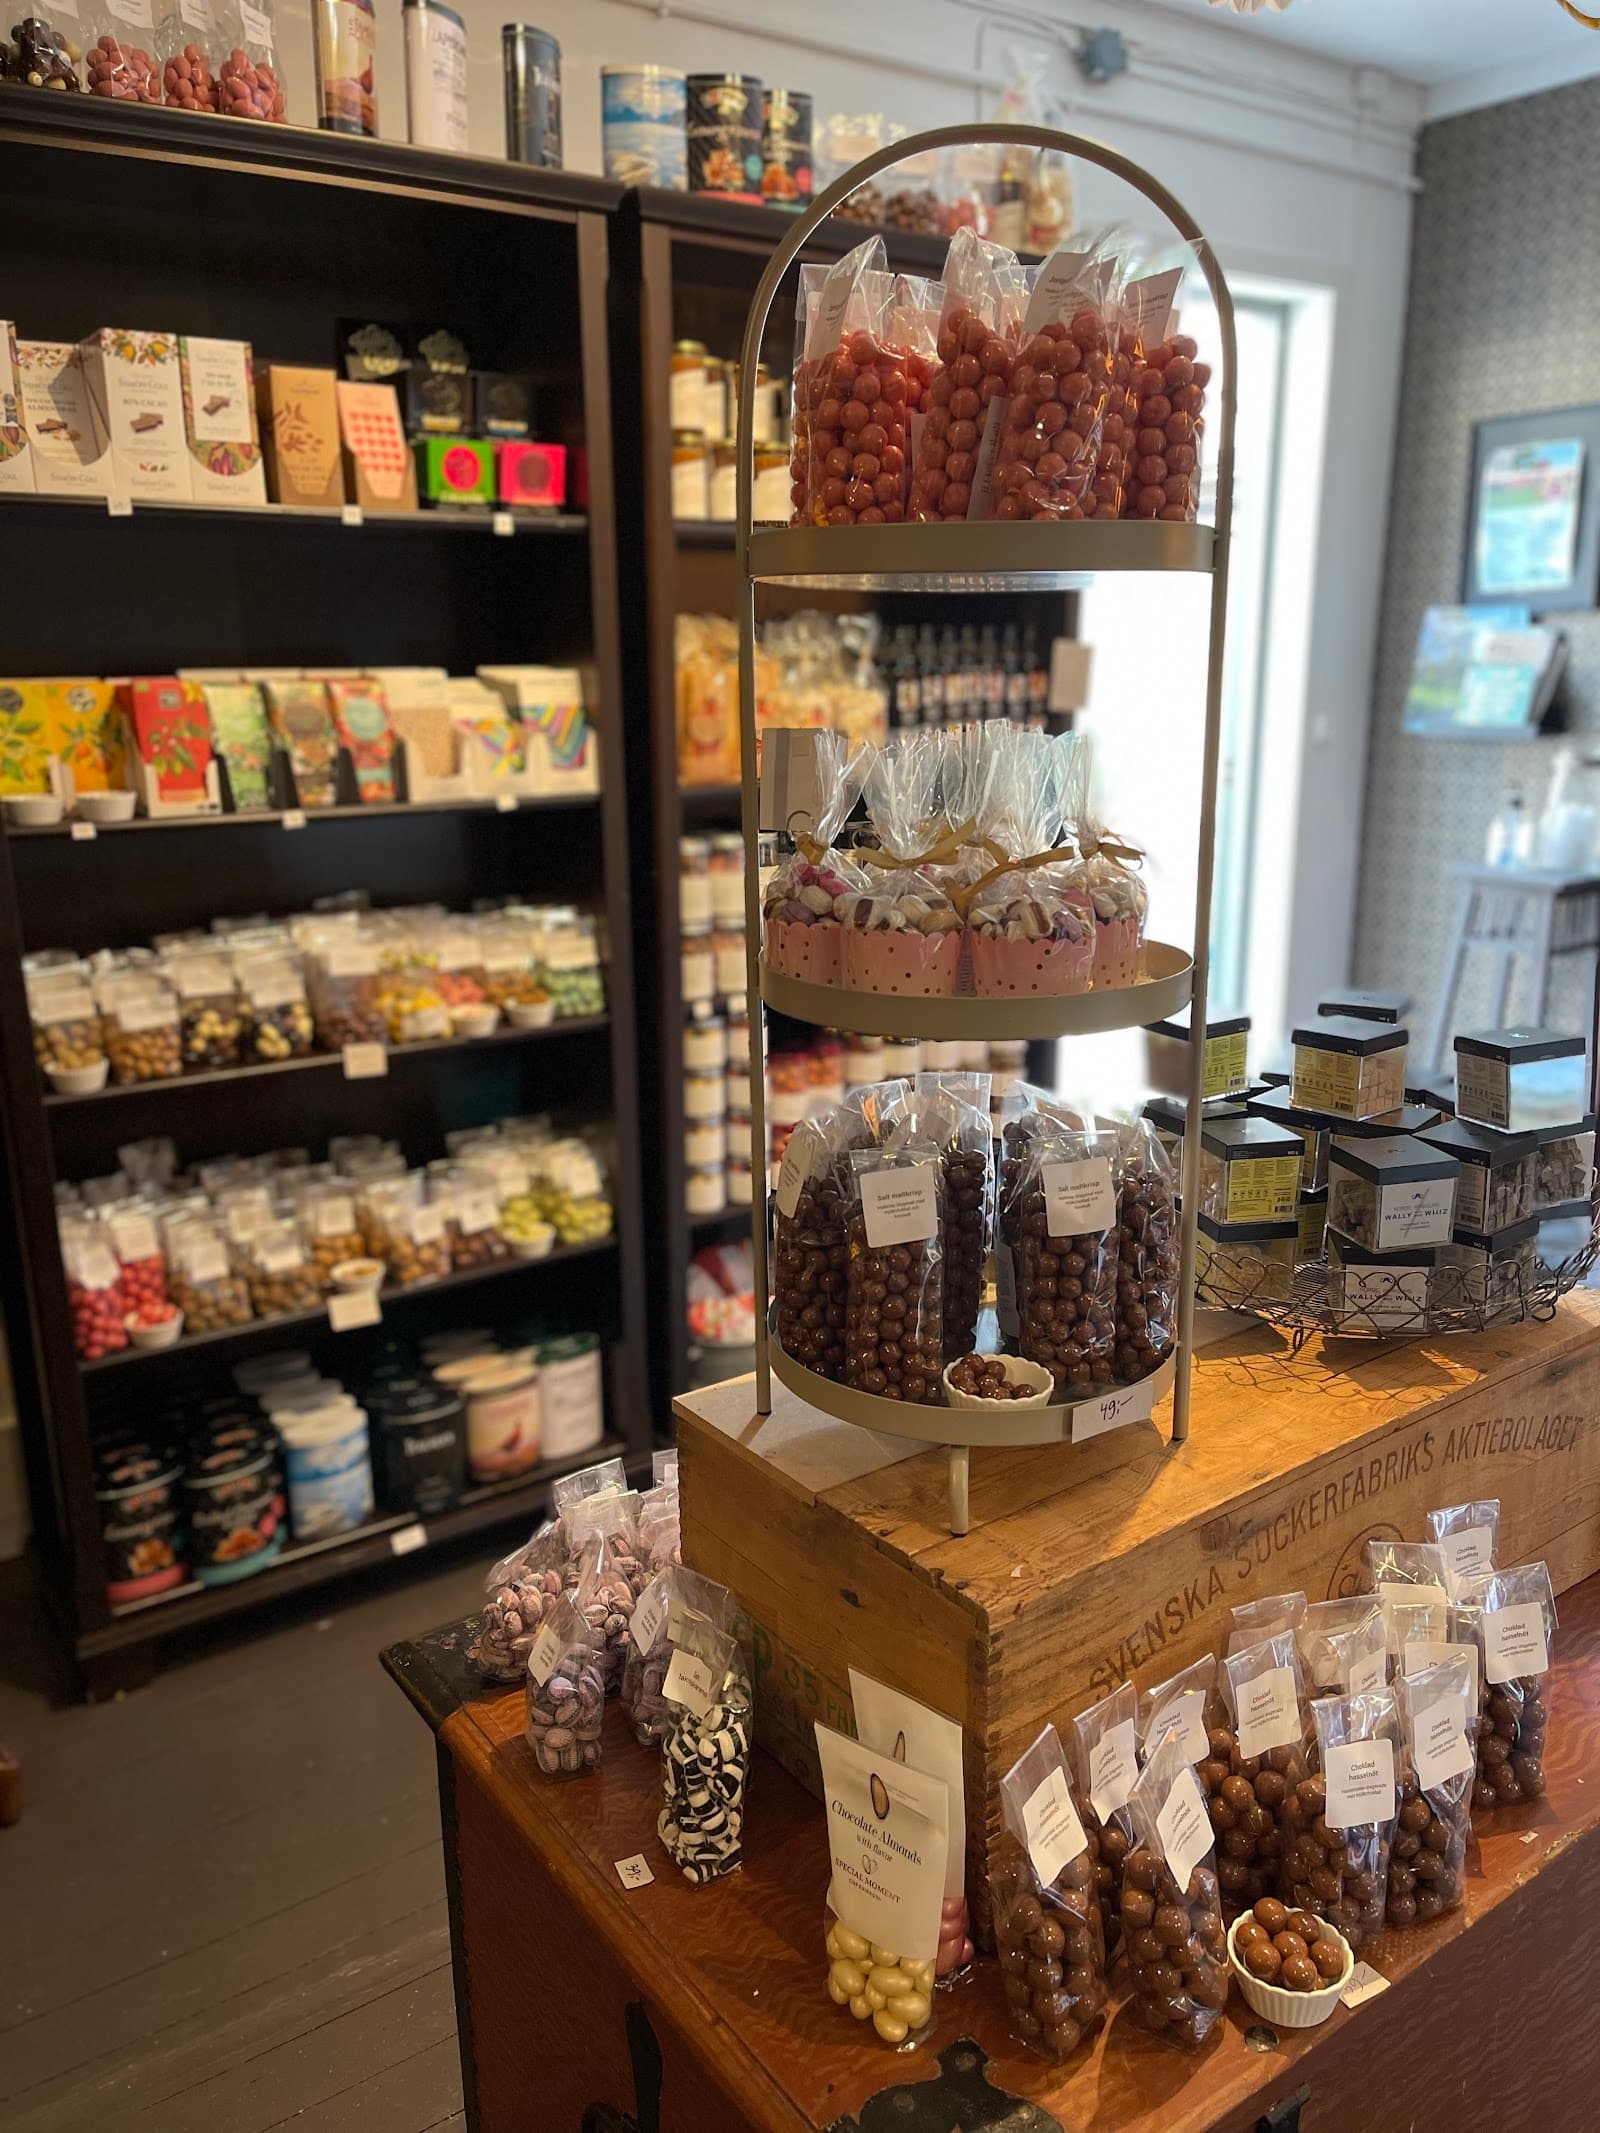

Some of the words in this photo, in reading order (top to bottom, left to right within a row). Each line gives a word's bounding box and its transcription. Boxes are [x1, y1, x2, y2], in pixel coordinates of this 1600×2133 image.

[1384, 1211, 1412, 1220] WALLY
[1088, 1565, 1225, 1696] SVENSKA
[1441, 1415, 1584, 1466] AKTIEBOLAGET
[1350, 1760, 1375, 1772] Choklad
[831, 1799, 878, 1837] Chocolate
[878, 1831, 922, 1866] Almonds
[856, 1834, 872, 1850] with
[873, 1844, 894, 1862] flavor
[834, 1857, 864, 1881] SPECIAL
[864, 1877, 901, 1904] MOMENT
